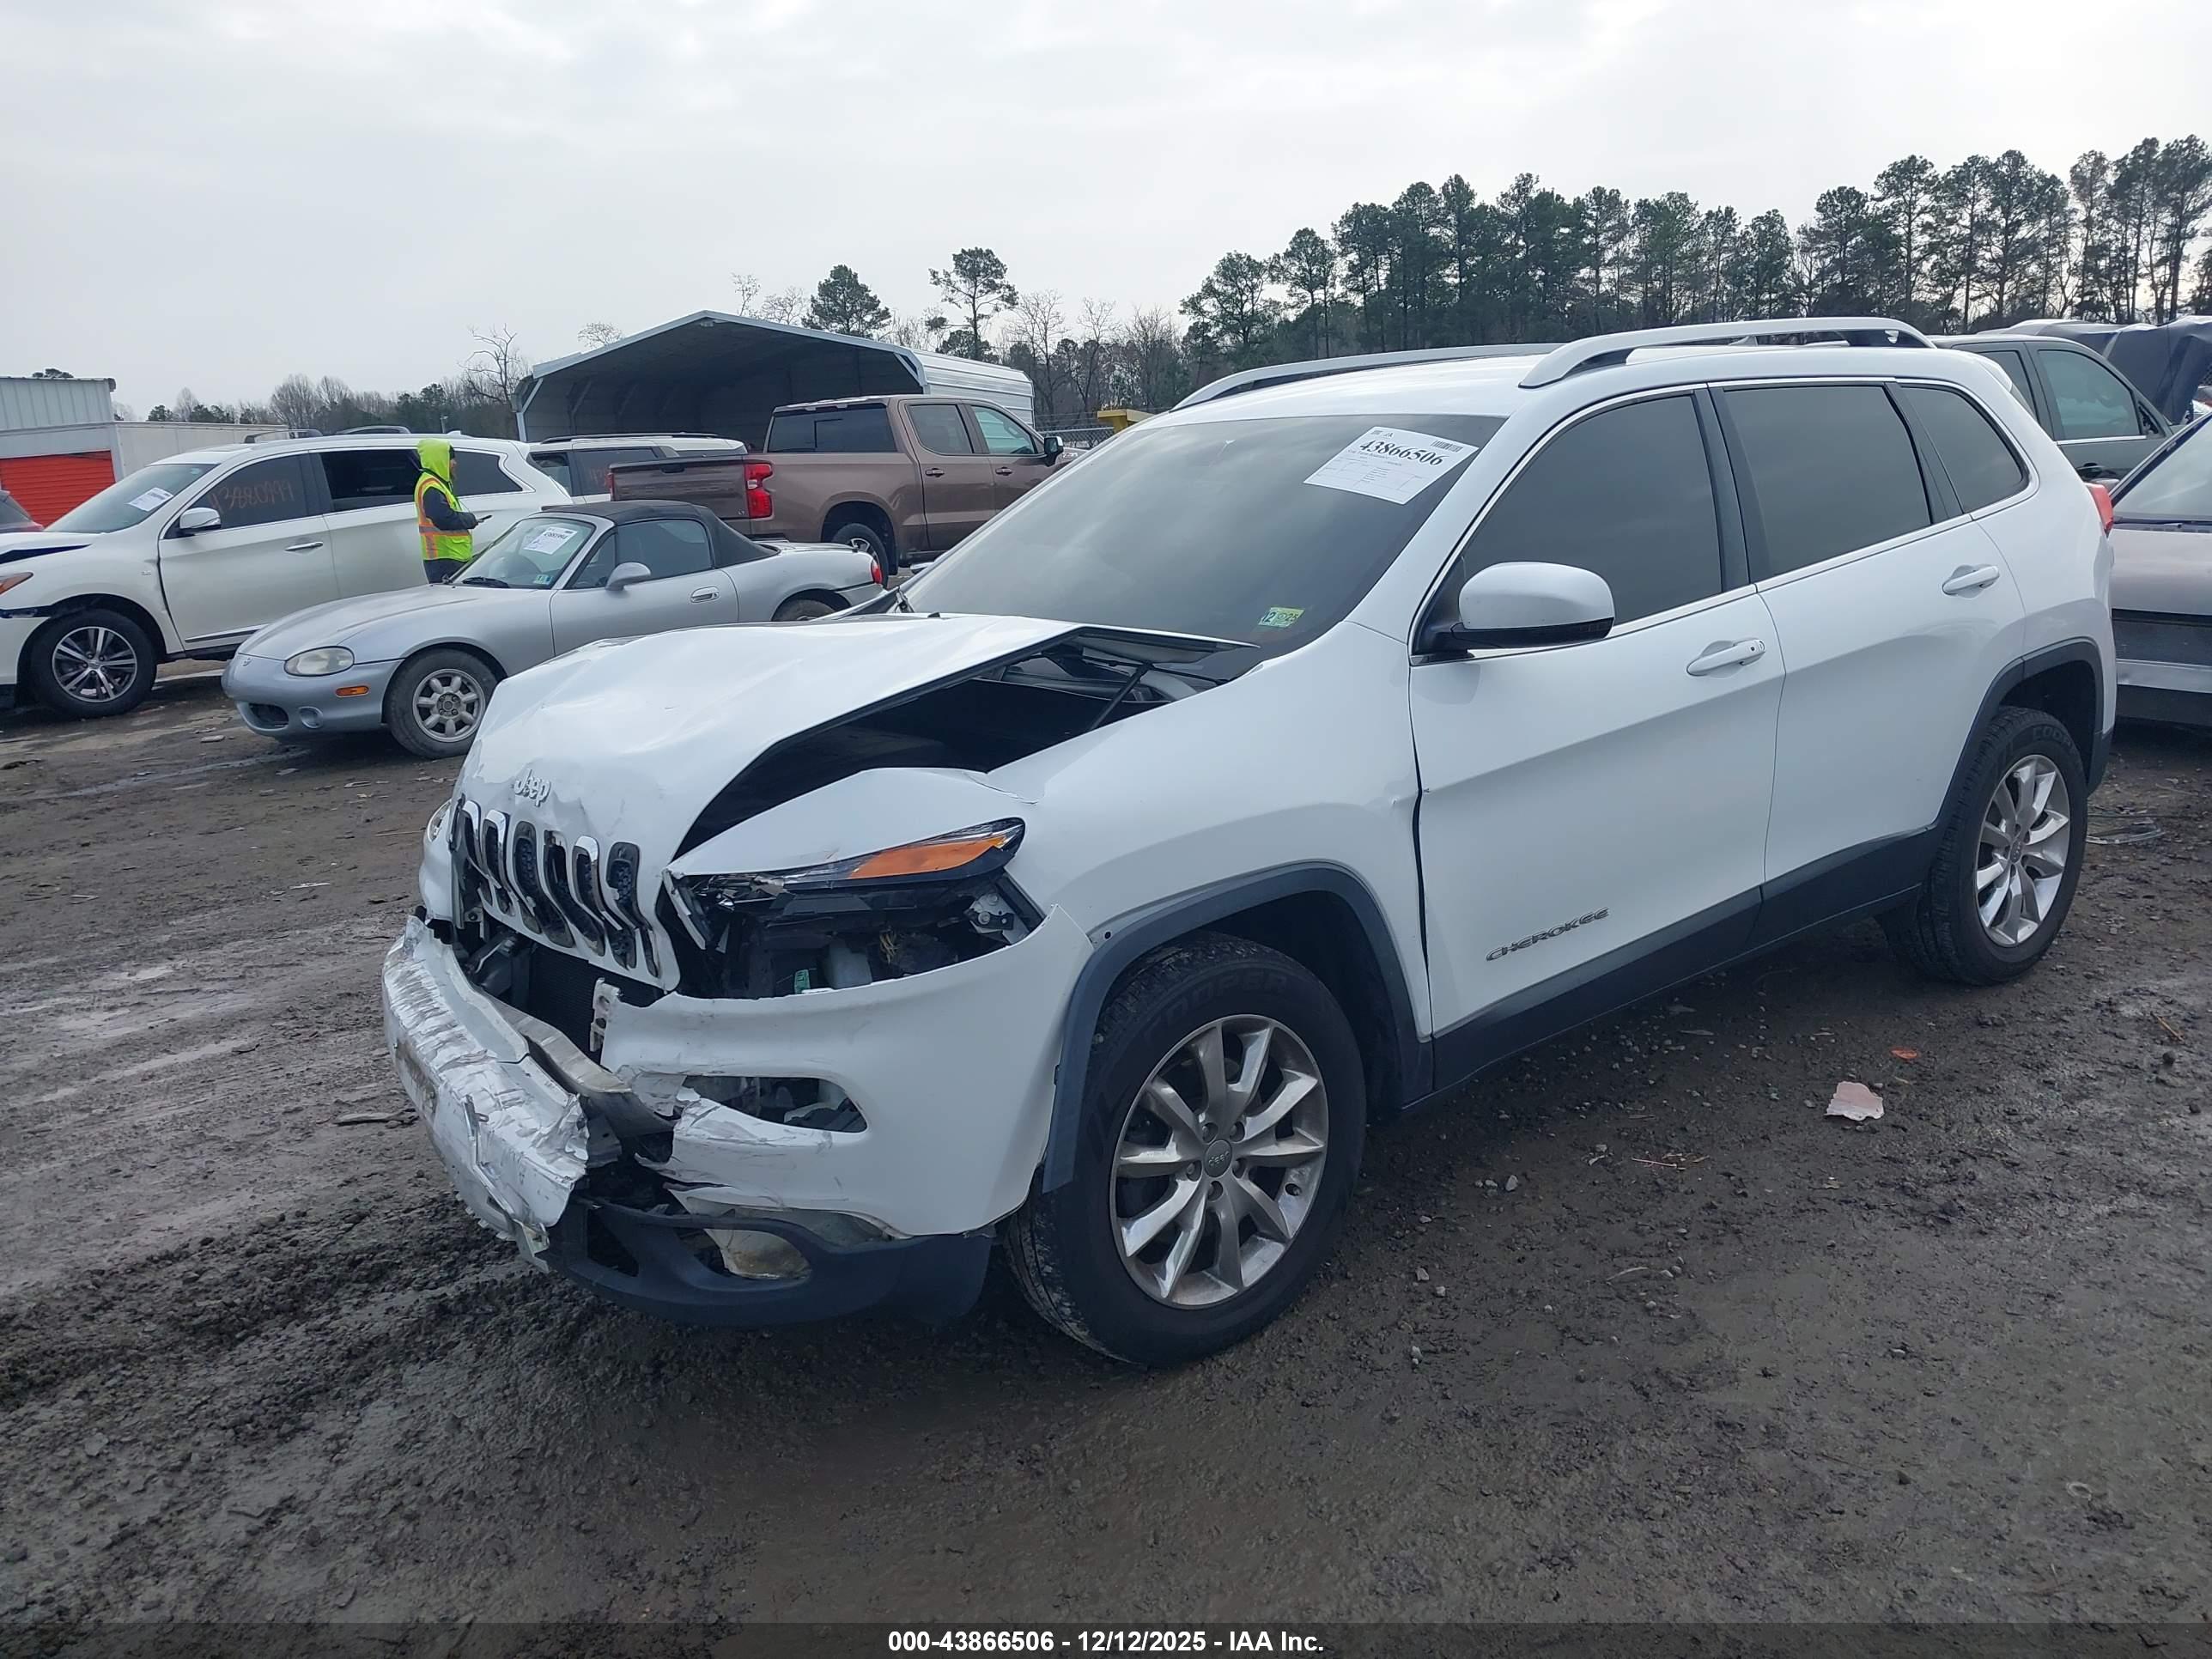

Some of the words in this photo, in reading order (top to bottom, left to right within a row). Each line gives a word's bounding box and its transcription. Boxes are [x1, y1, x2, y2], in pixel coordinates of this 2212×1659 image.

[1359, 439, 1450, 466] 43866506
[1261, 611, 1277, 623] 12
[514, 769, 551, 807] Jeep
[1486, 906, 1609, 962] CHEROKEE
